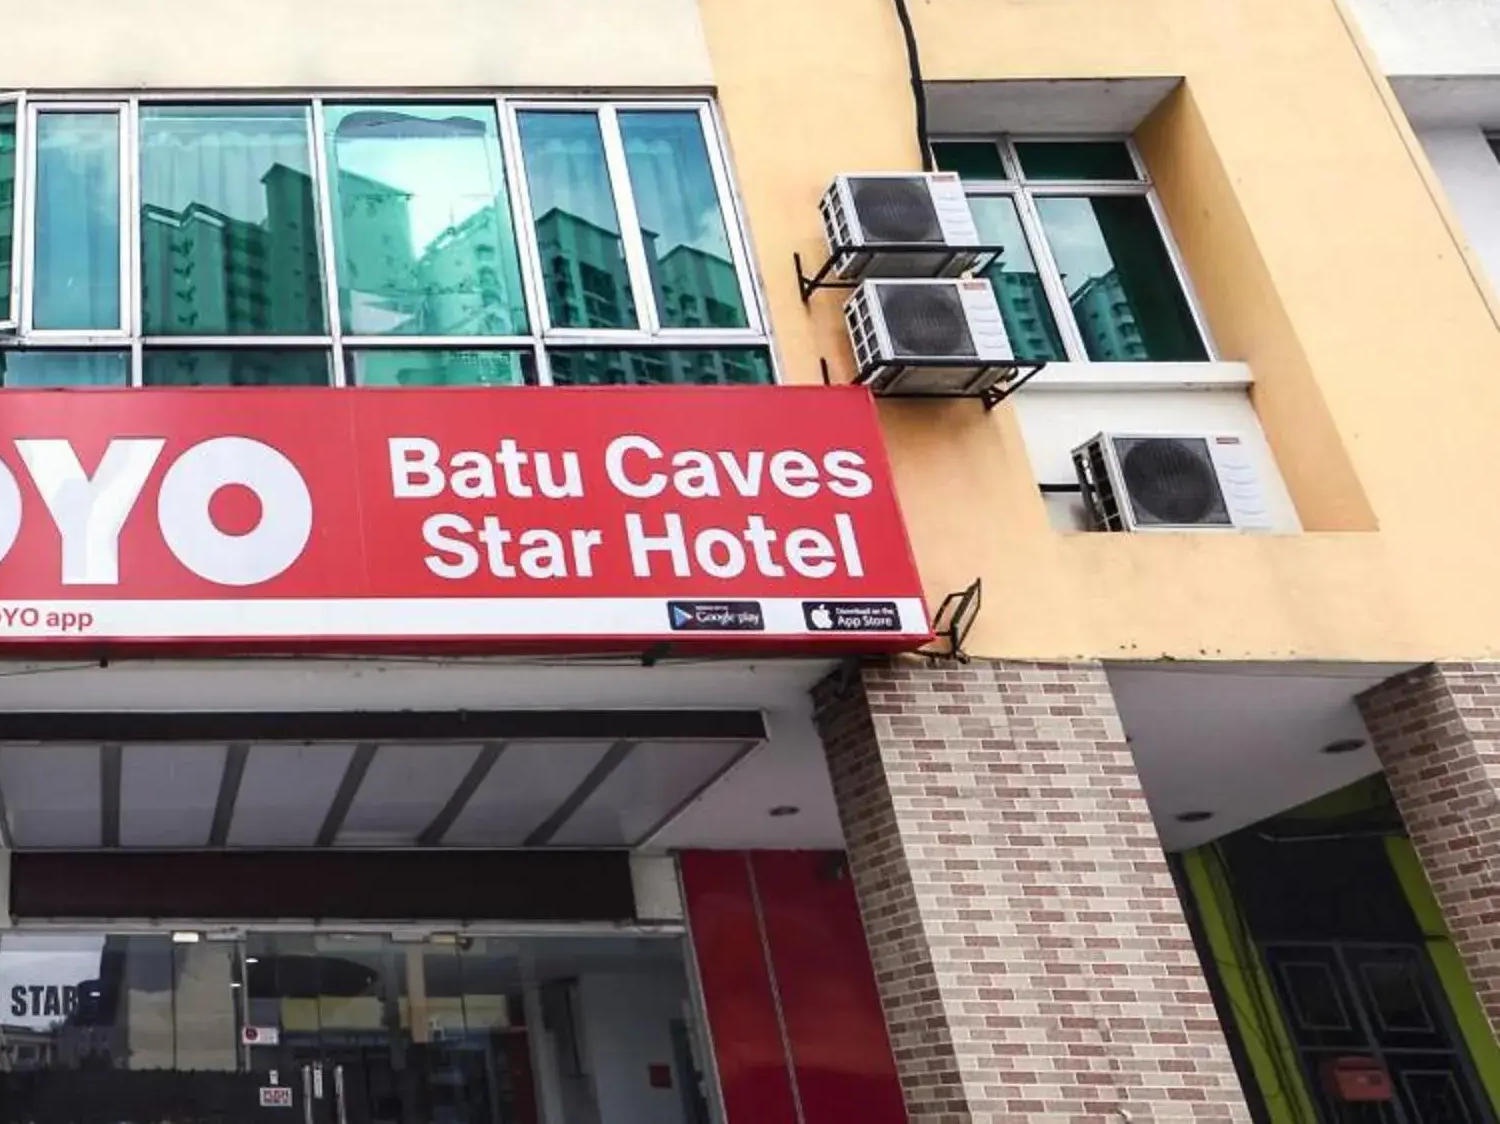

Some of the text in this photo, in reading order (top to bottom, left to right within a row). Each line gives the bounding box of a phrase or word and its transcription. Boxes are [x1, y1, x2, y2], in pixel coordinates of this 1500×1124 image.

[387, 435, 873, 499] Batu Caves
[421, 512, 865, 580] Star Hotel
[46, 612, 93, 632] app
[837, 615, 893, 628] App Store
